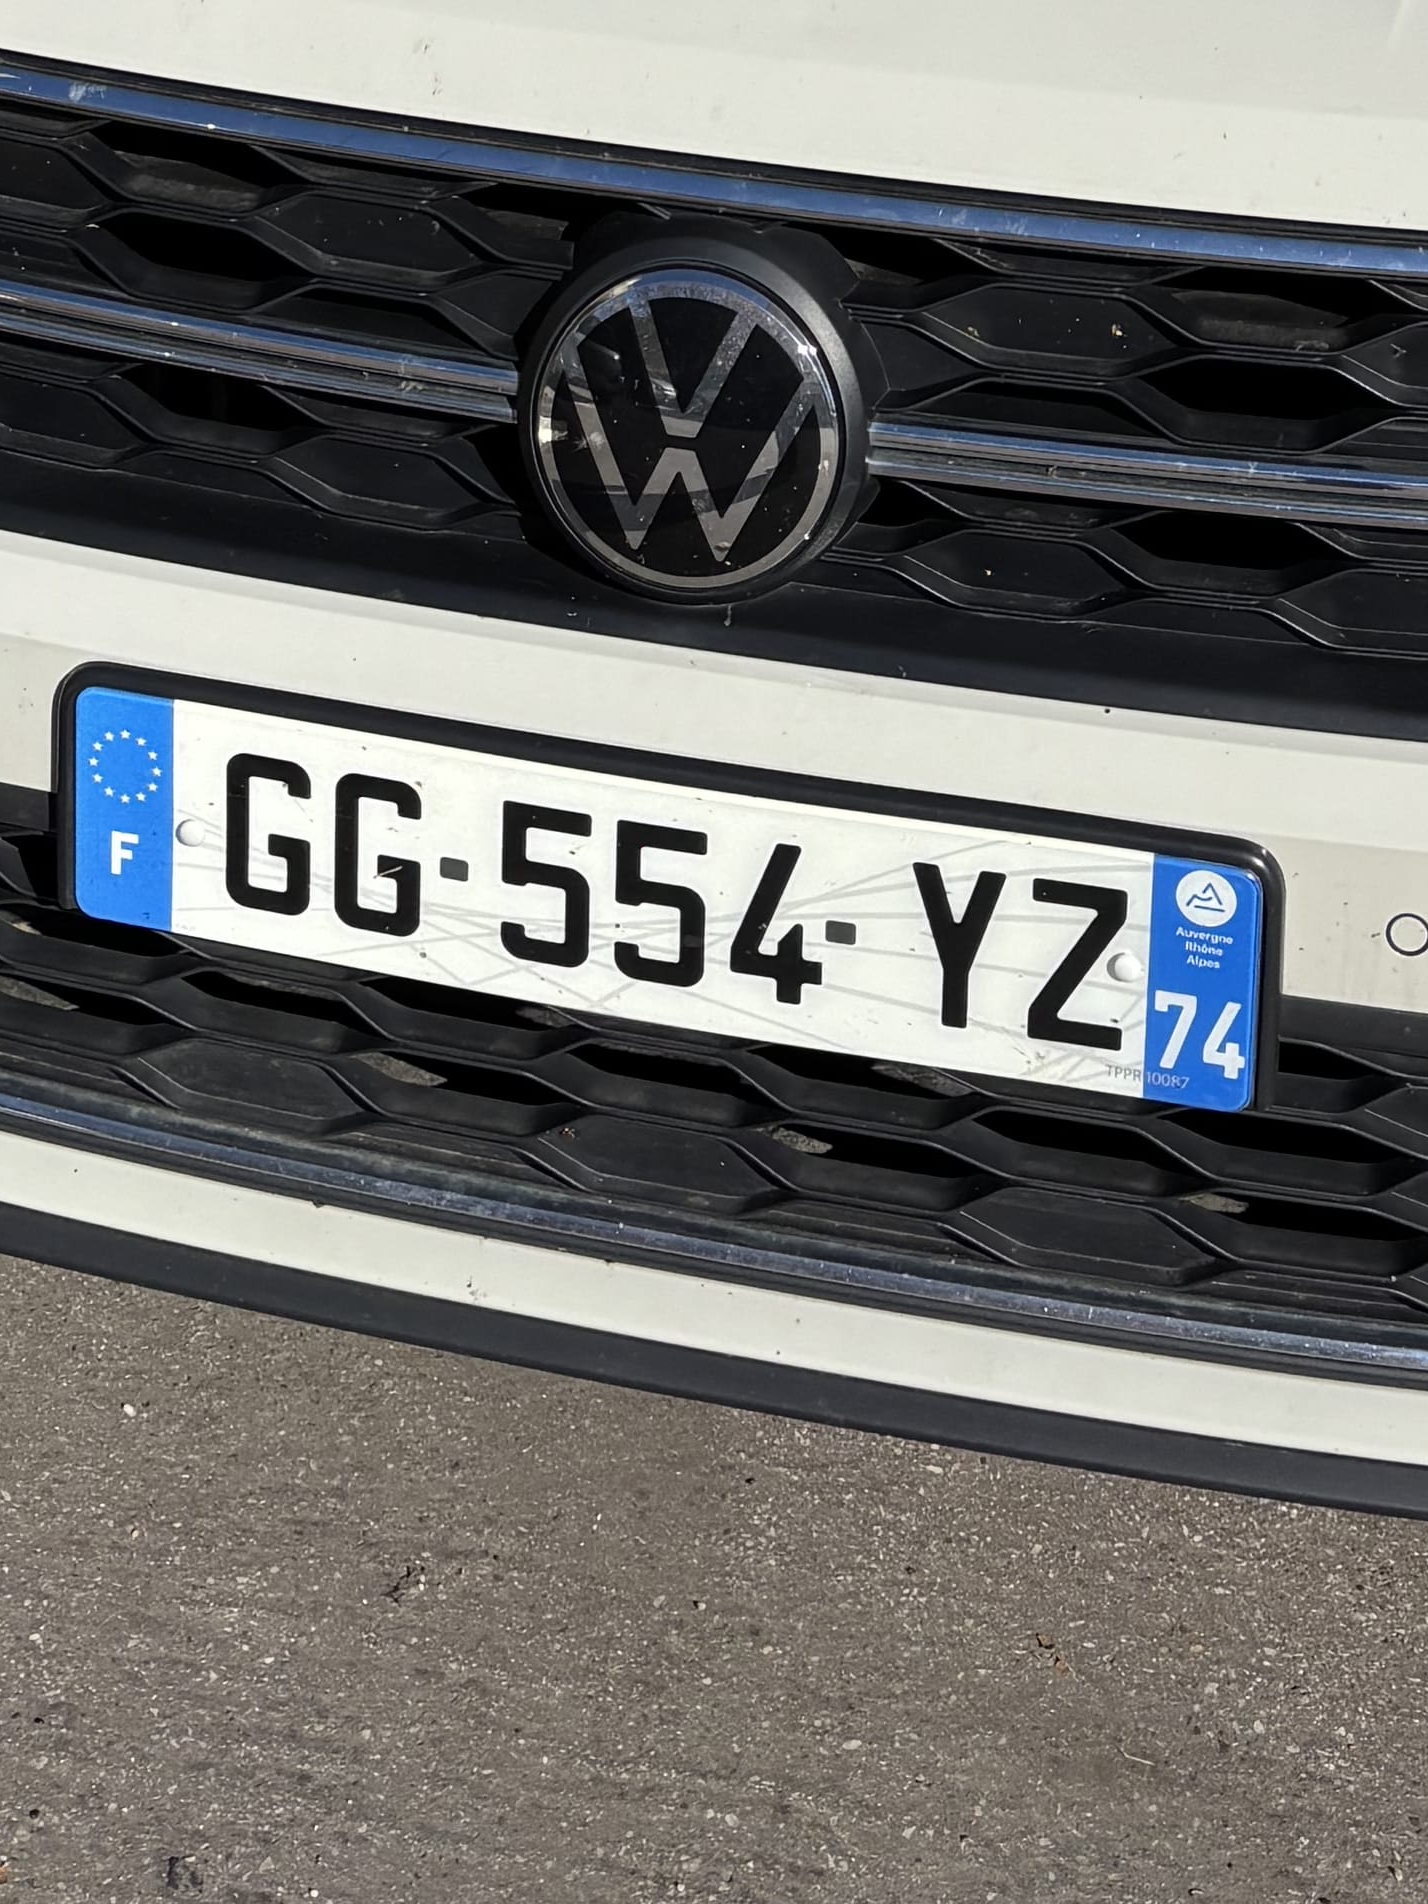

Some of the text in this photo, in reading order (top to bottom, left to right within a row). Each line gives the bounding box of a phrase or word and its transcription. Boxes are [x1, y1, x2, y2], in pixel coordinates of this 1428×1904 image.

[110, 830, 140, 876] F
[225, 752, 1129, 1052] GG-554-YZ
[1175, 926, 1234, 945] Auvergne
[1186, 954, 1221, 969] Alpes
[1154, 990, 1246, 1081] 74
